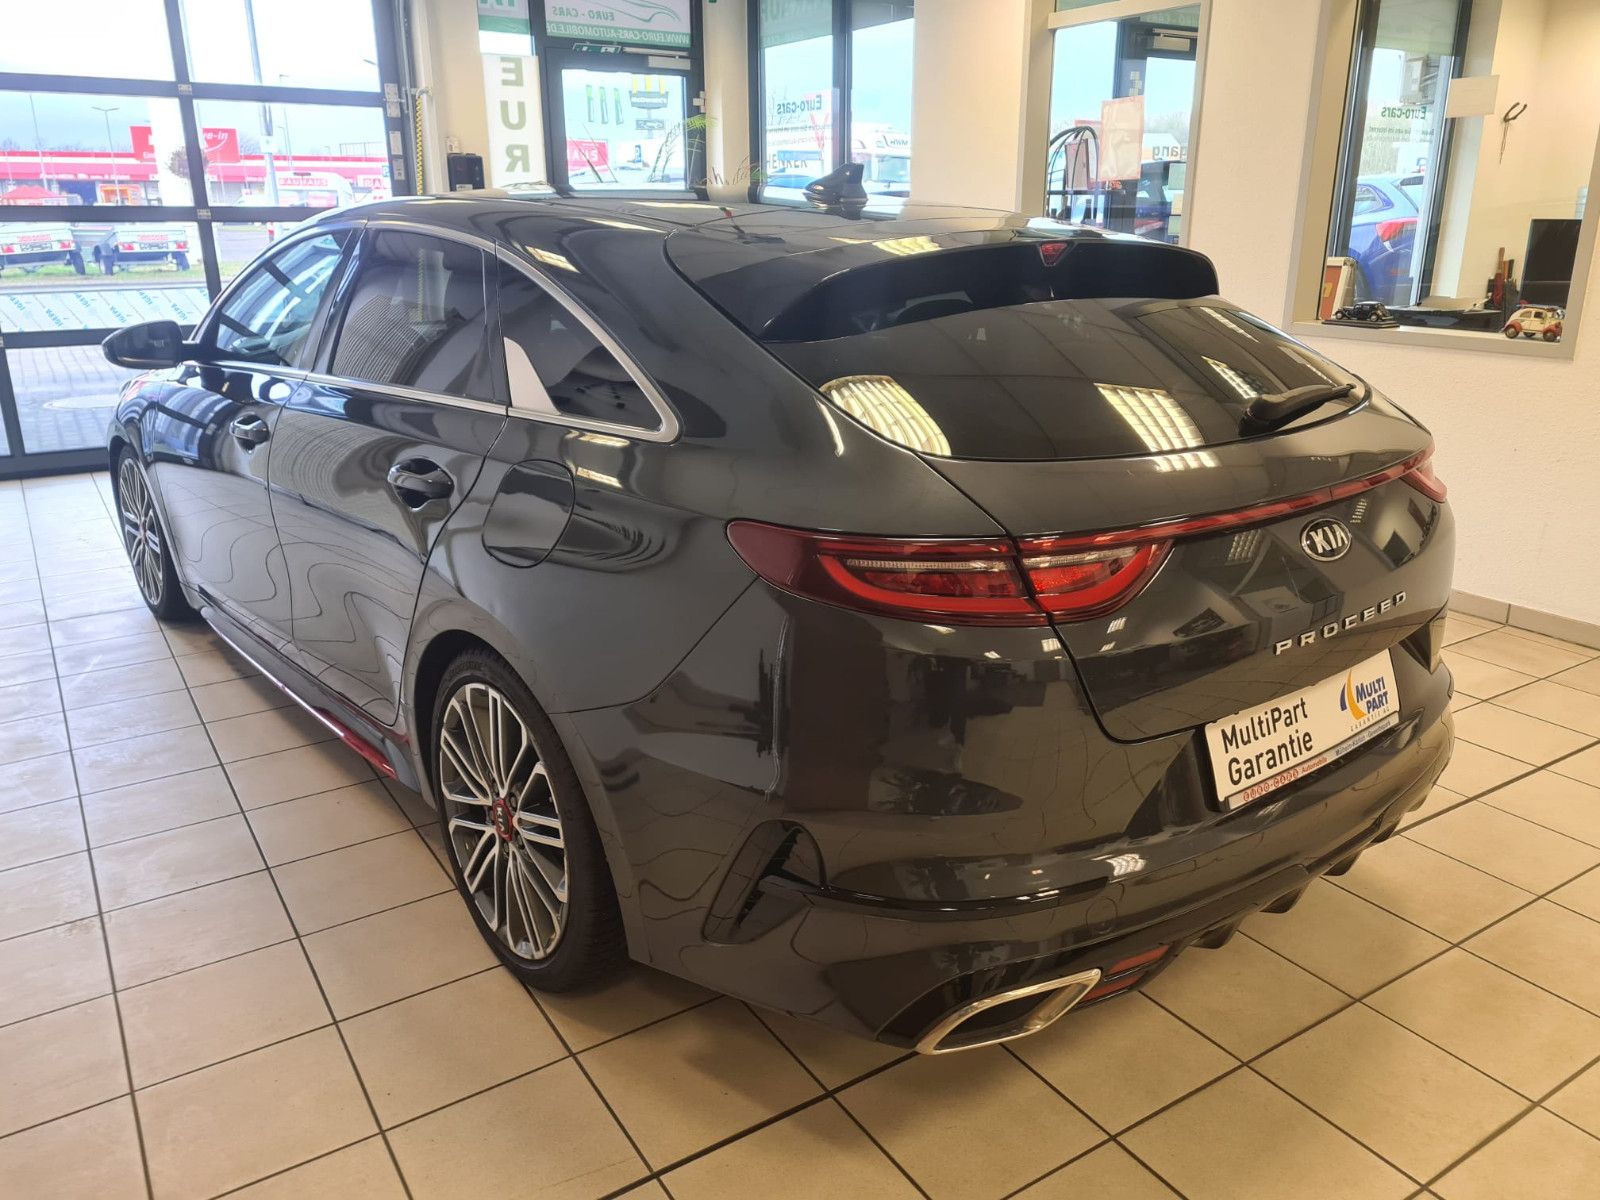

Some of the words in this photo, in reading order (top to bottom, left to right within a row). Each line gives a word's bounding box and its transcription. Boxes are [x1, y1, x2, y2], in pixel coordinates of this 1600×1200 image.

[1309, 523, 1348, 554] KIA
[1274, 591, 1407, 656] PROCEED
[1355, 676, 1386, 704] MULTI
[1366, 690, 1388, 714] PART
[1220, 697, 1309, 754] MultiPart
[1228, 729, 1314, 786] Garantie
